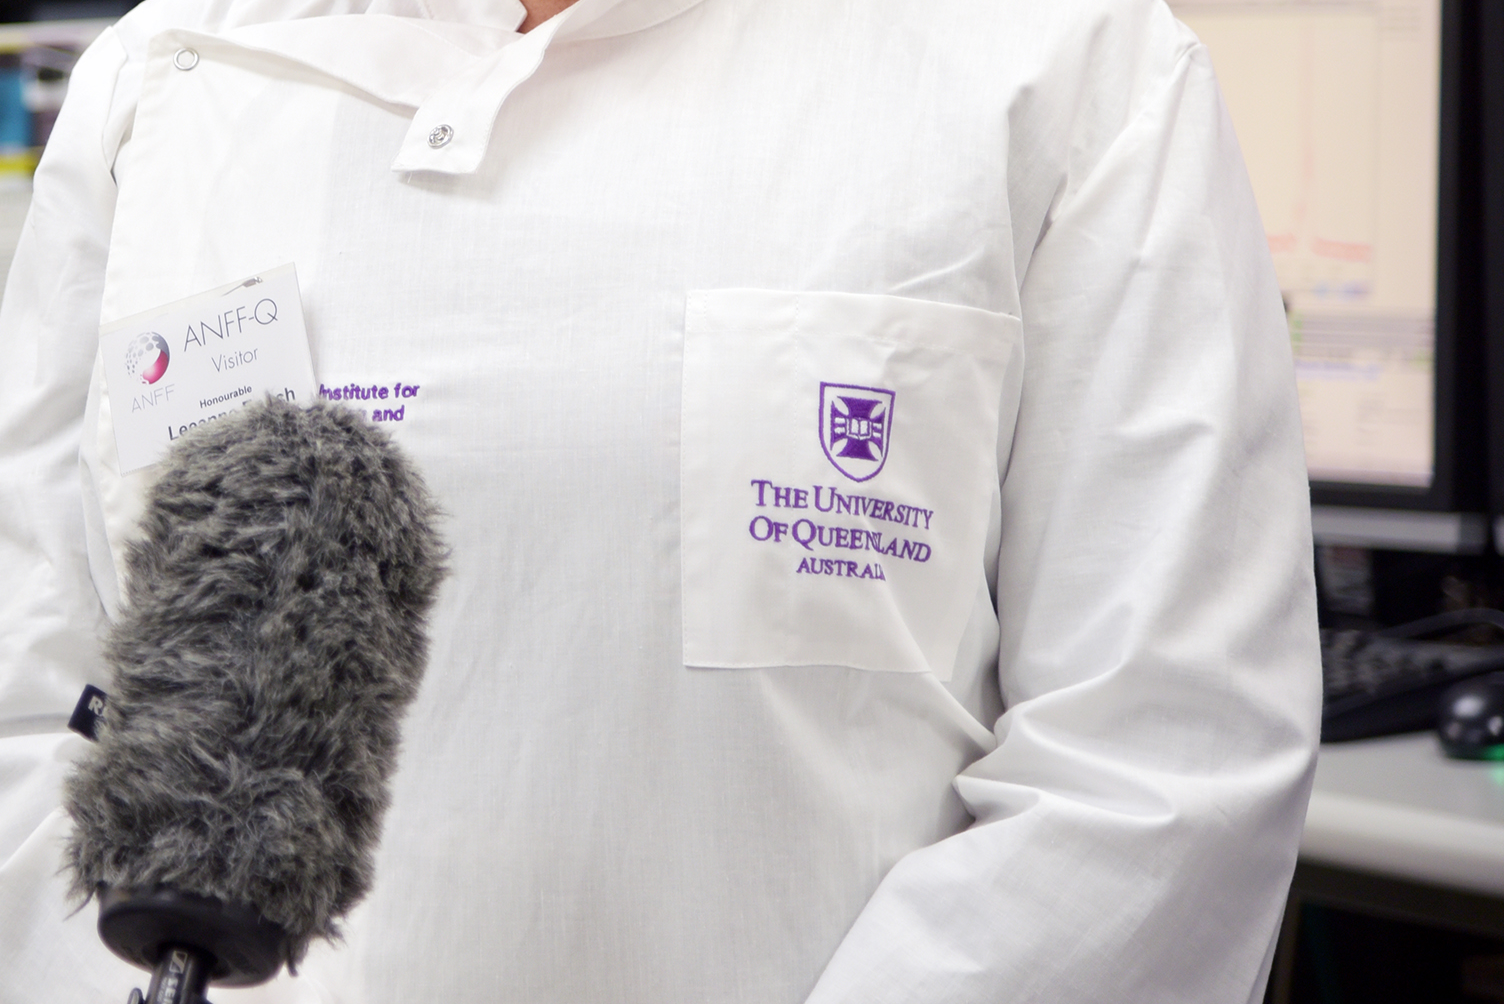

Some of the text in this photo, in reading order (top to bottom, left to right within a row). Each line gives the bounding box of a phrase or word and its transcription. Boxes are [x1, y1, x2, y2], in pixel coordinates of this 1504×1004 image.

[182, 297, 279, 353] ANFF-Q
[210, 346, 259, 373] Visitor
[131, 384, 176, 414] ANFF
[198, 384, 253, 409] Honourable
[394, 381, 421, 399] for
[371, 404, 406, 423] and
[812, 484, 934, 530] UNIVERSITY
[796, 556, 887, 582] AUSTRALI
